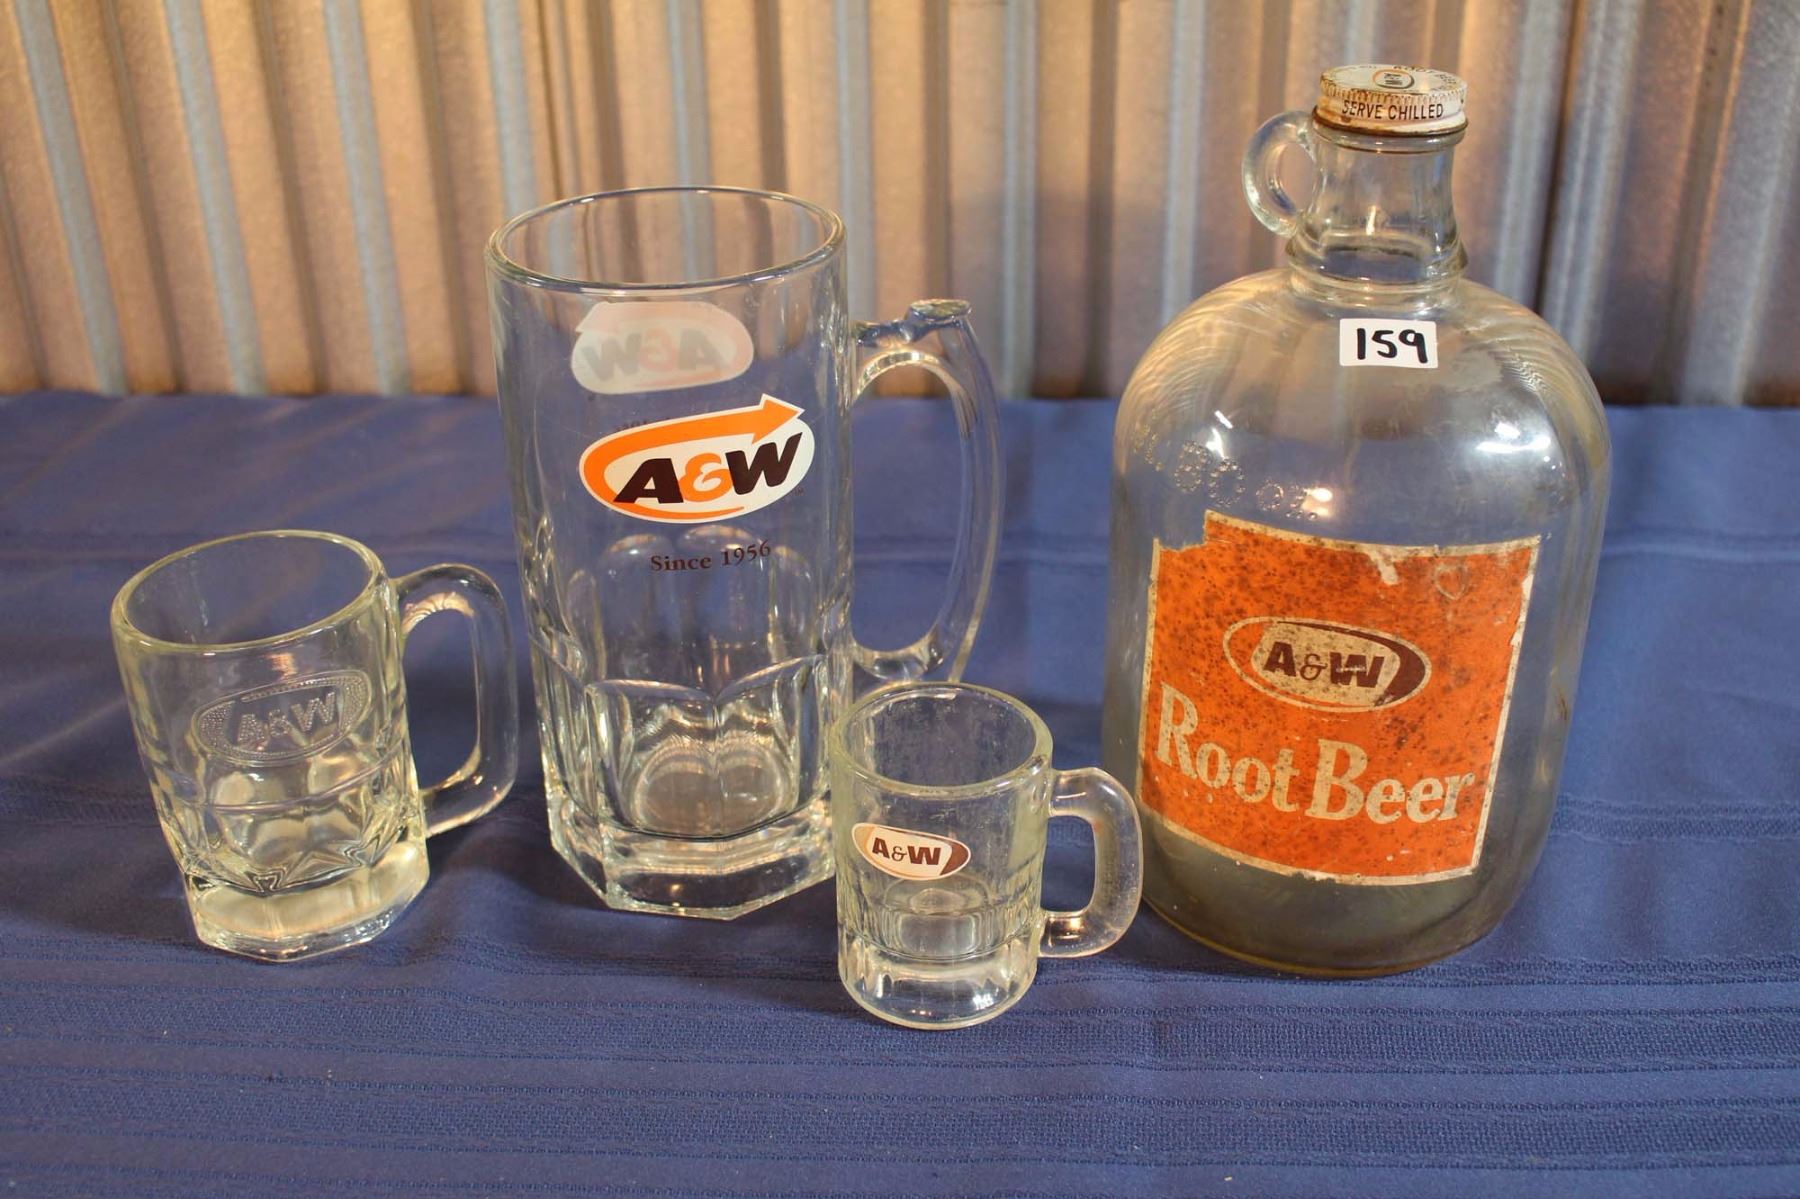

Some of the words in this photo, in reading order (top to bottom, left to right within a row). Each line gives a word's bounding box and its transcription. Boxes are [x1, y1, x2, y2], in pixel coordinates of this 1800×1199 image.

[1341, 99, 1382, 120] SERVE
[1388, 103, 1444, 121] CHILLED
[1356, 327, 1429, 364] 159
[613, 432, 803, 504] A&W
[650, 554, 712, 572] Since
[721, 538, 772, 567] 1956
[1263, 640, 1385, 689] A&W
[1155, 681, 1300, 813] Root
[1304, 738, 1476, 825] Beer
[871, 836, 942, 866] A&W
